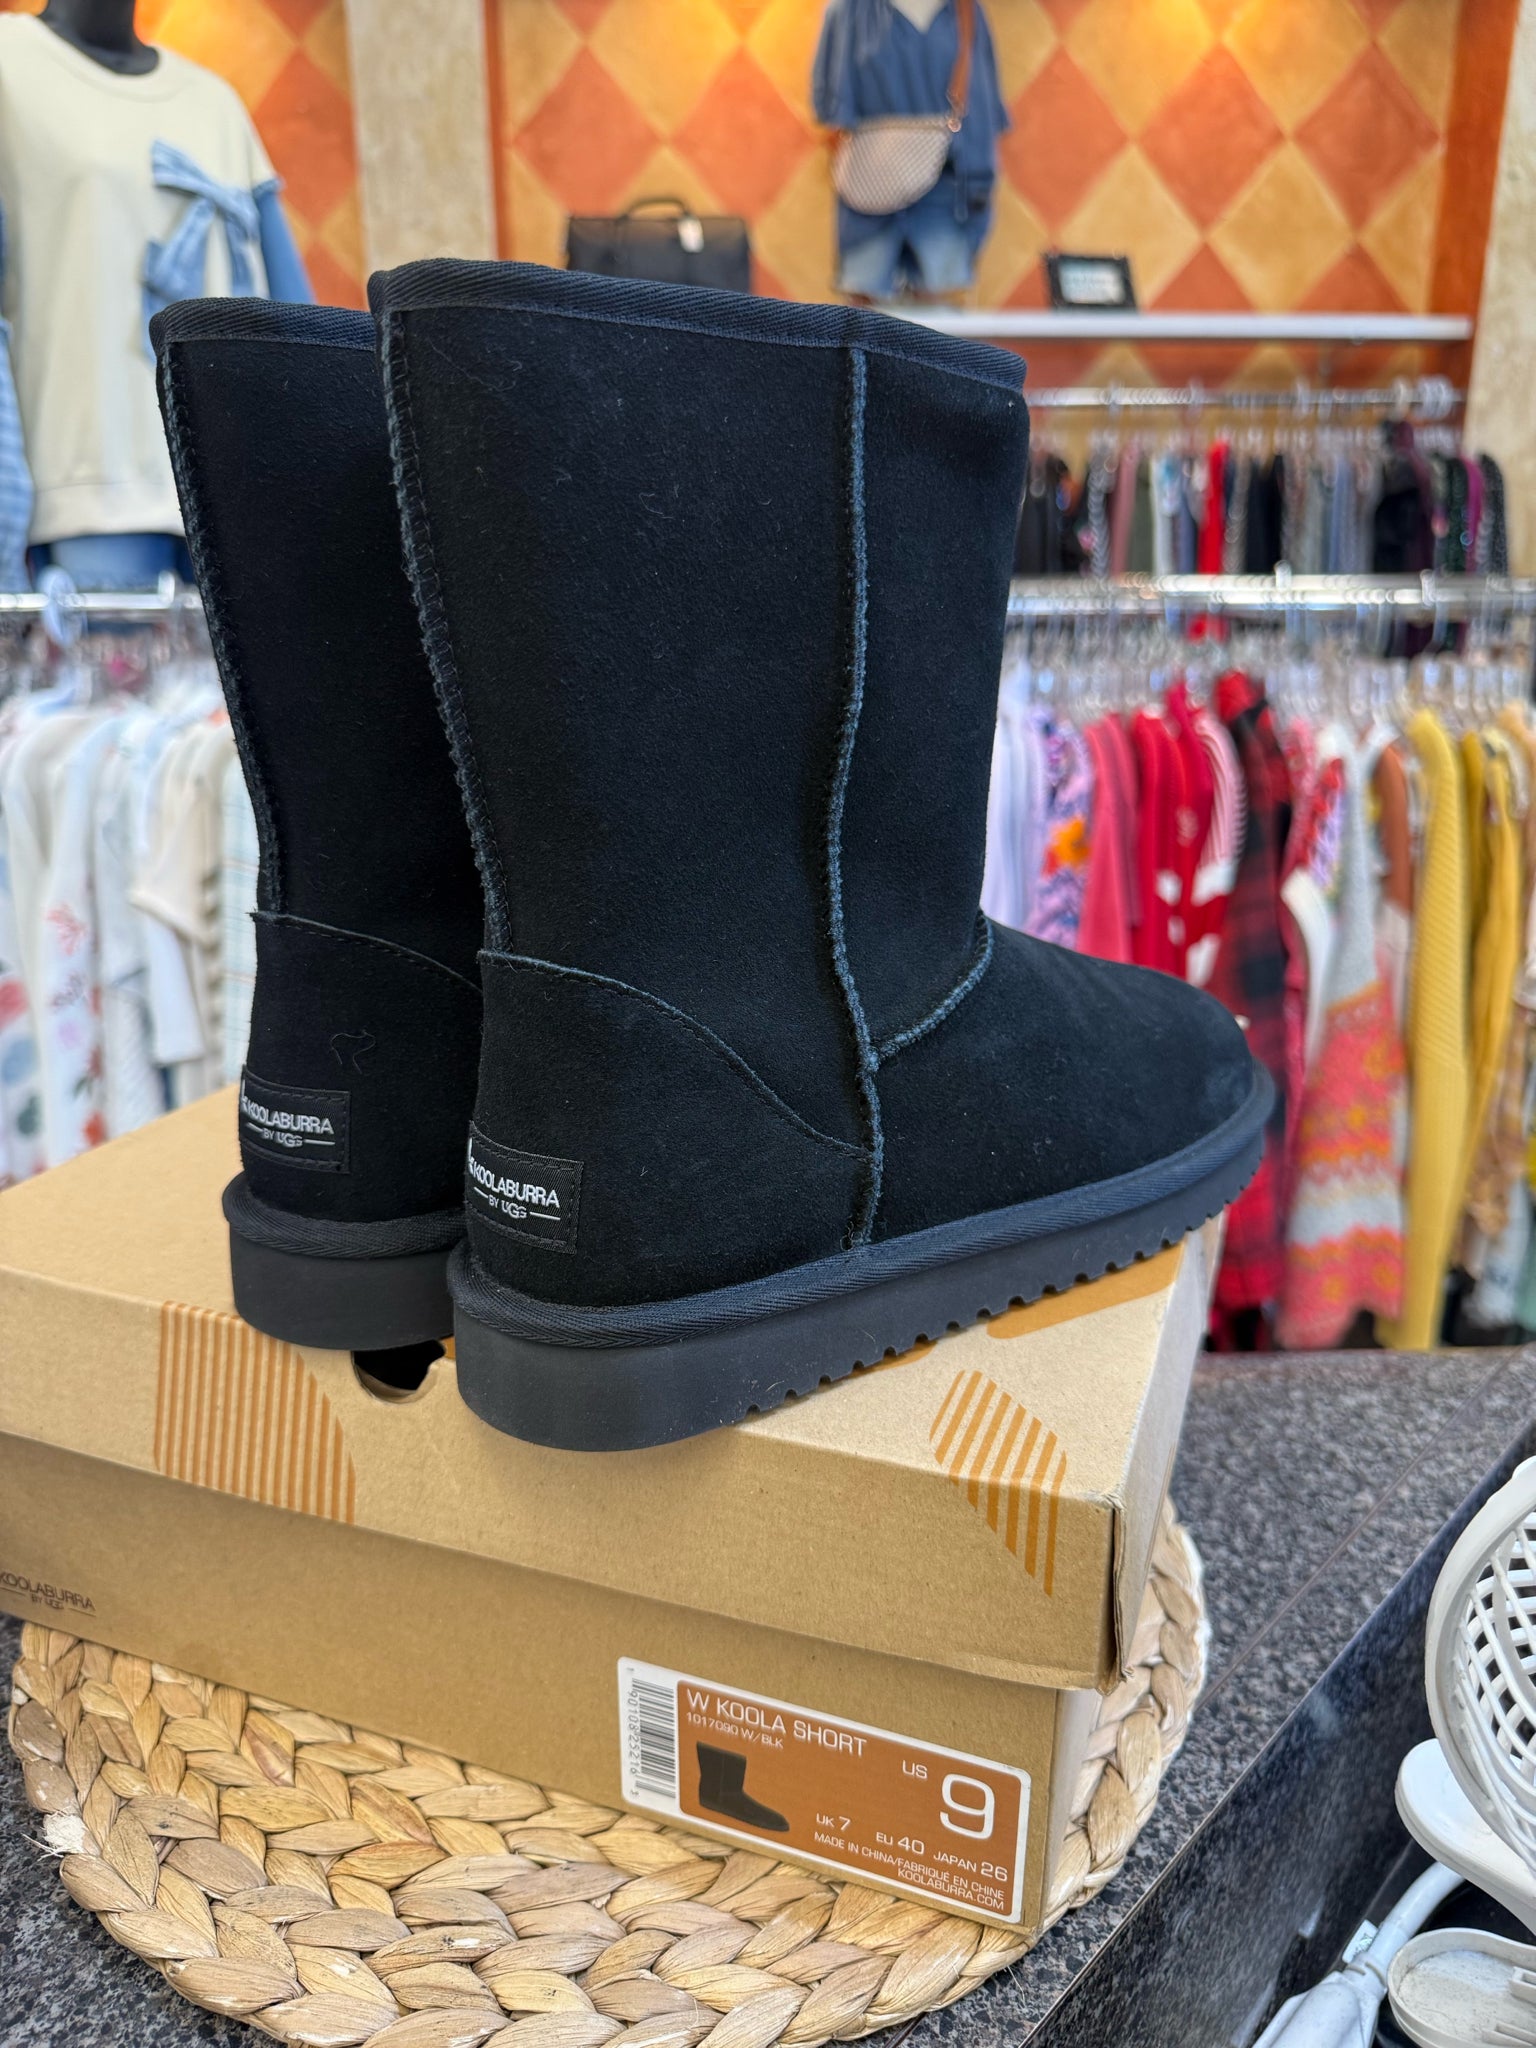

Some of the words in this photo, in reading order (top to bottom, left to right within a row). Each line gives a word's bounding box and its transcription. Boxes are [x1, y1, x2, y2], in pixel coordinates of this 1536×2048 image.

[247, 1100, 334, 1134] KOOLABURRA
[263, 1127, 274, 1140] BY
[473, 1163, 560, 1208] KOOLABURRA
[488, 1194, 499, 1208] BY
[687, 1688, 710, 1712] W
[716, 1697, 786, 1735] KOOLA
[793, 1719, 867, 1757] SHORT
[740, 1728, 783, 1749] W/BLK
[902, 1760, 928, 1780] US
[940, 1773, 995, 1839] 9
[816, 1813, 834, 1827] UK
[838, 1815, 851, 1831] 7
[876, 1831, 894, 1846] EU
[897, 1836, 925, 1855] 40
[814, 1831, 845, 1849] MADE
[848, 1842, 859, 1854] IN
[953, 1874, 968, 1888] EN
[971, 1880, 1005, 1901] CHINE
[933, 1851, 977, 1872] JAPAN
[980, 1861, 1008, 1883] 26
[897, 1867, 1005, 1911] KOOLABURRA.COM
